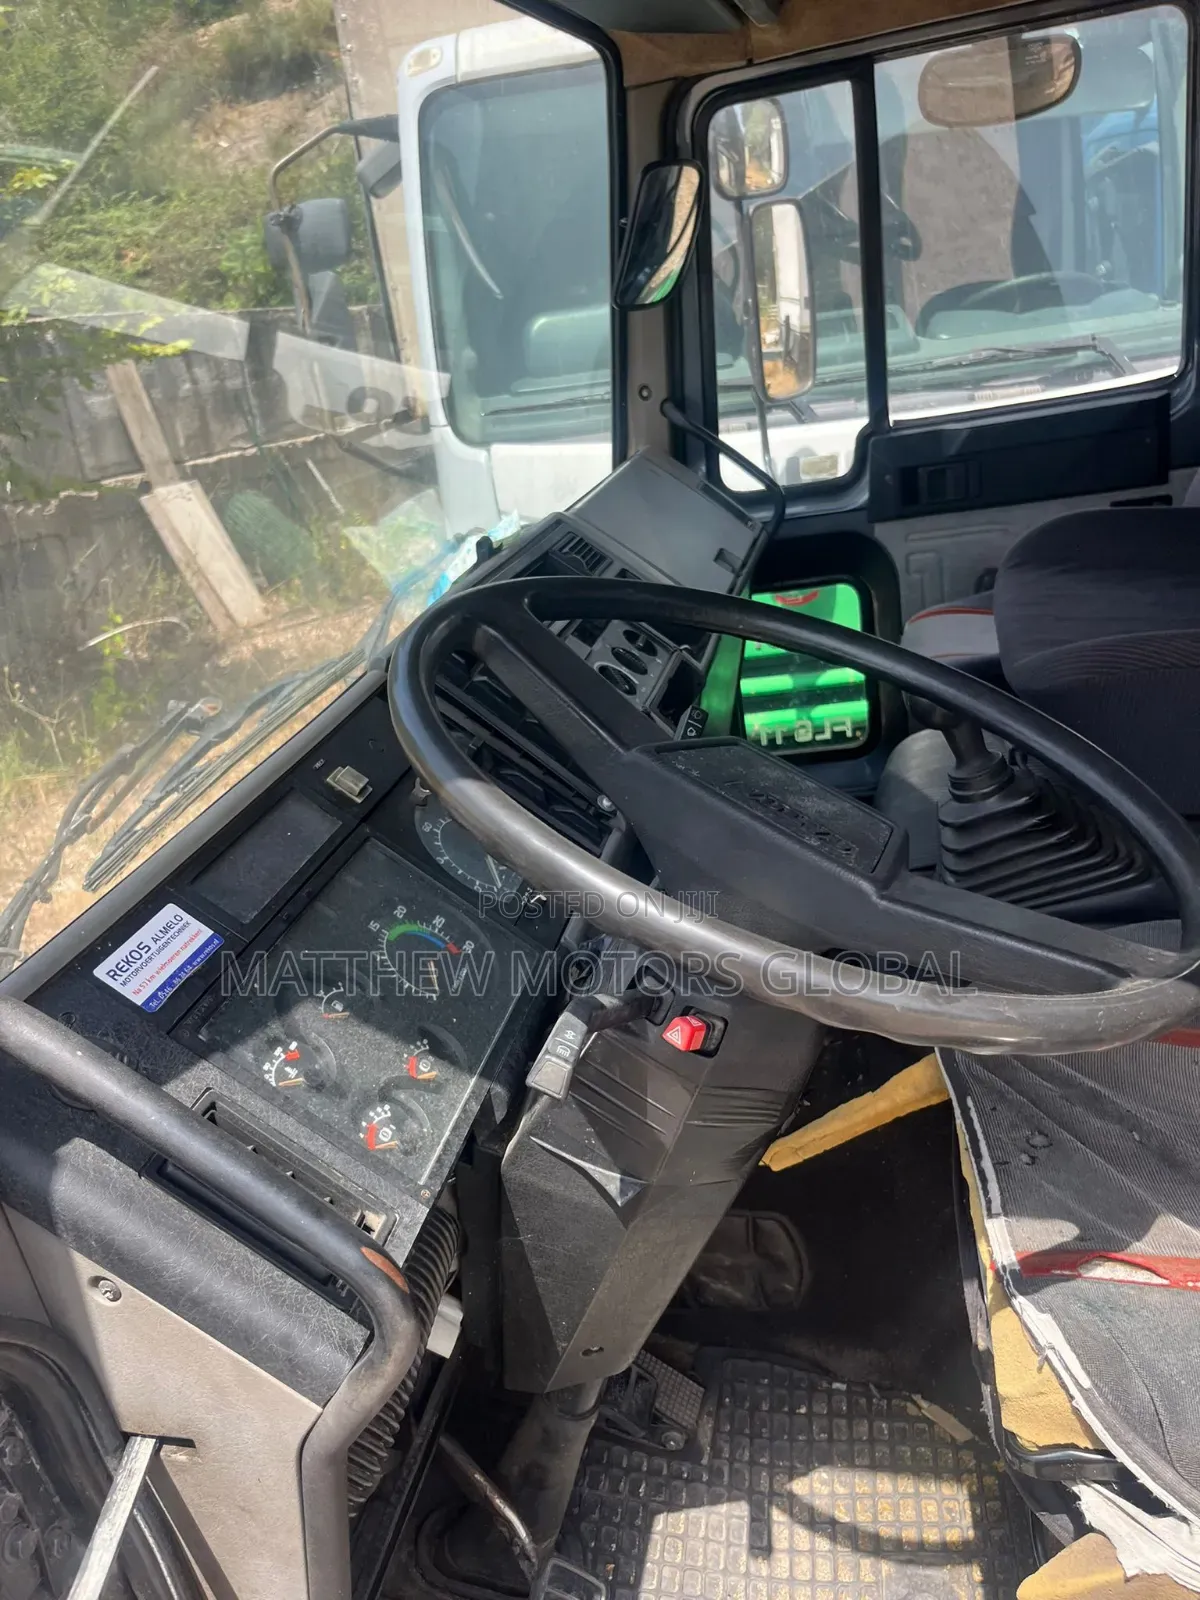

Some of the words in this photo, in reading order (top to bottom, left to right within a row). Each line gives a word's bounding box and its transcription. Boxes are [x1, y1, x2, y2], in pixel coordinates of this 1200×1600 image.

[368, 920, 381, 932] 15
[393, 905, 407, 919] 20
[106, 941, 151, 982] REKOS
[151, 914, 184, 945] ALMELO
[120, 921, 192, 987] MOTORVOERTUIGENTECHNIEK
